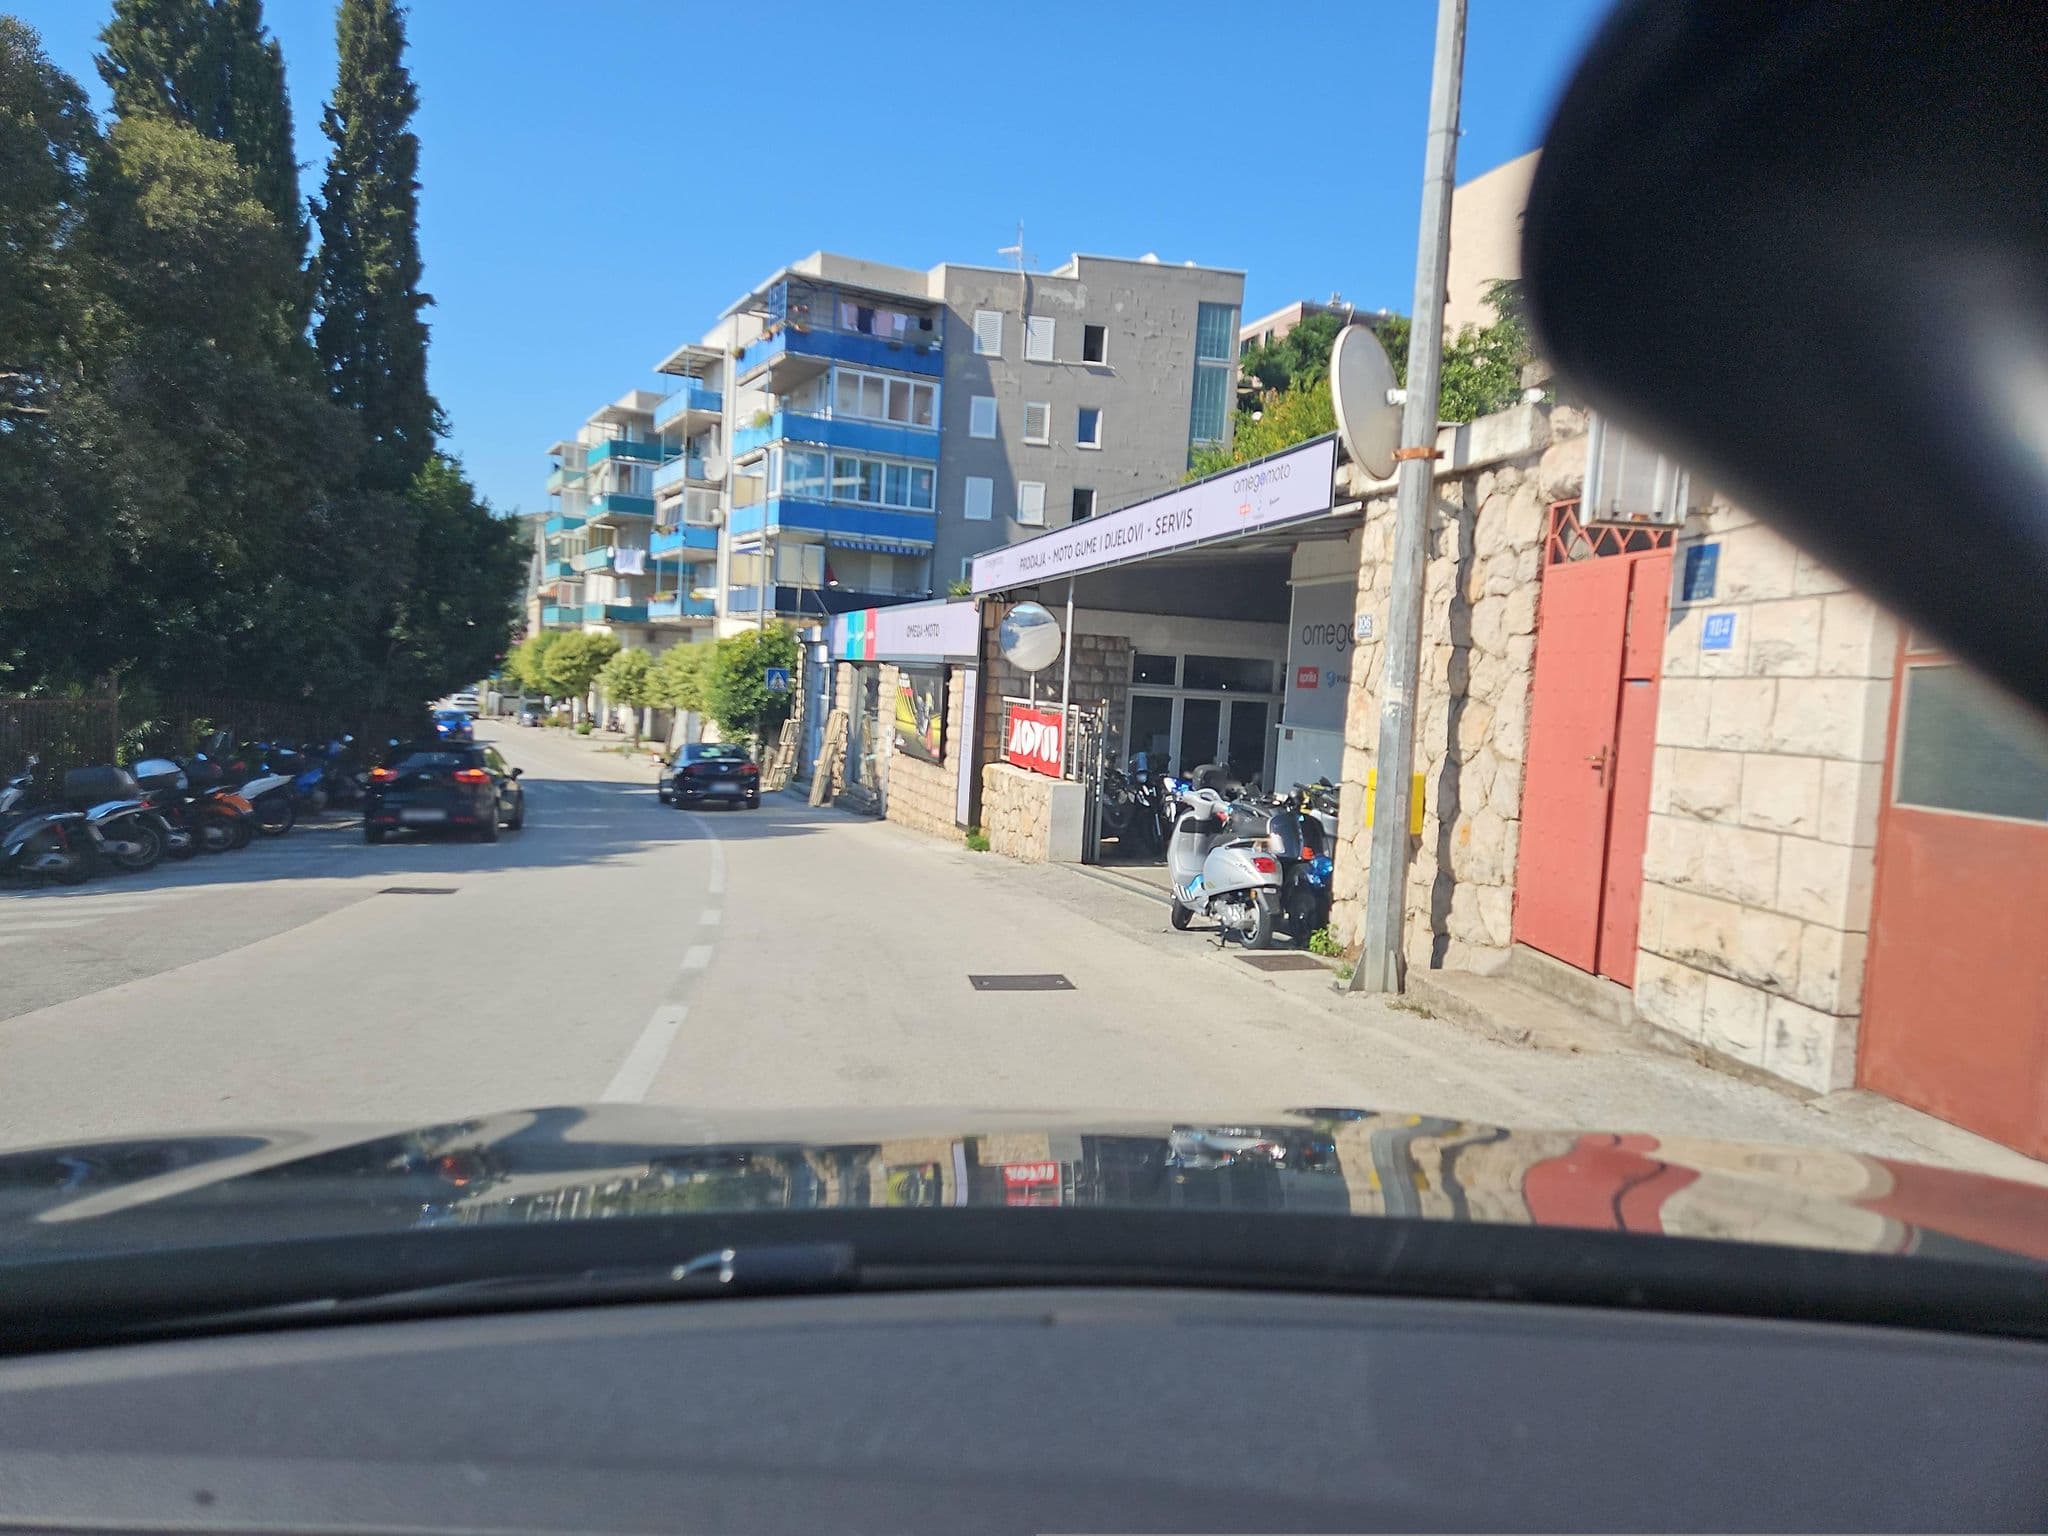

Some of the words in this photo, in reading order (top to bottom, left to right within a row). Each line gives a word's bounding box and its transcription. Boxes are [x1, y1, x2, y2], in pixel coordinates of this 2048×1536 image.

[1019, 552, 1046, 571] PRODAJA
[1053, 544, 1074, 563] MOTO
[1075, 537, 1098, 557] GUME
[1105, 522, 1144, 550] DIJELOVI
[1155, 508, 1193, 536] SERVIS
